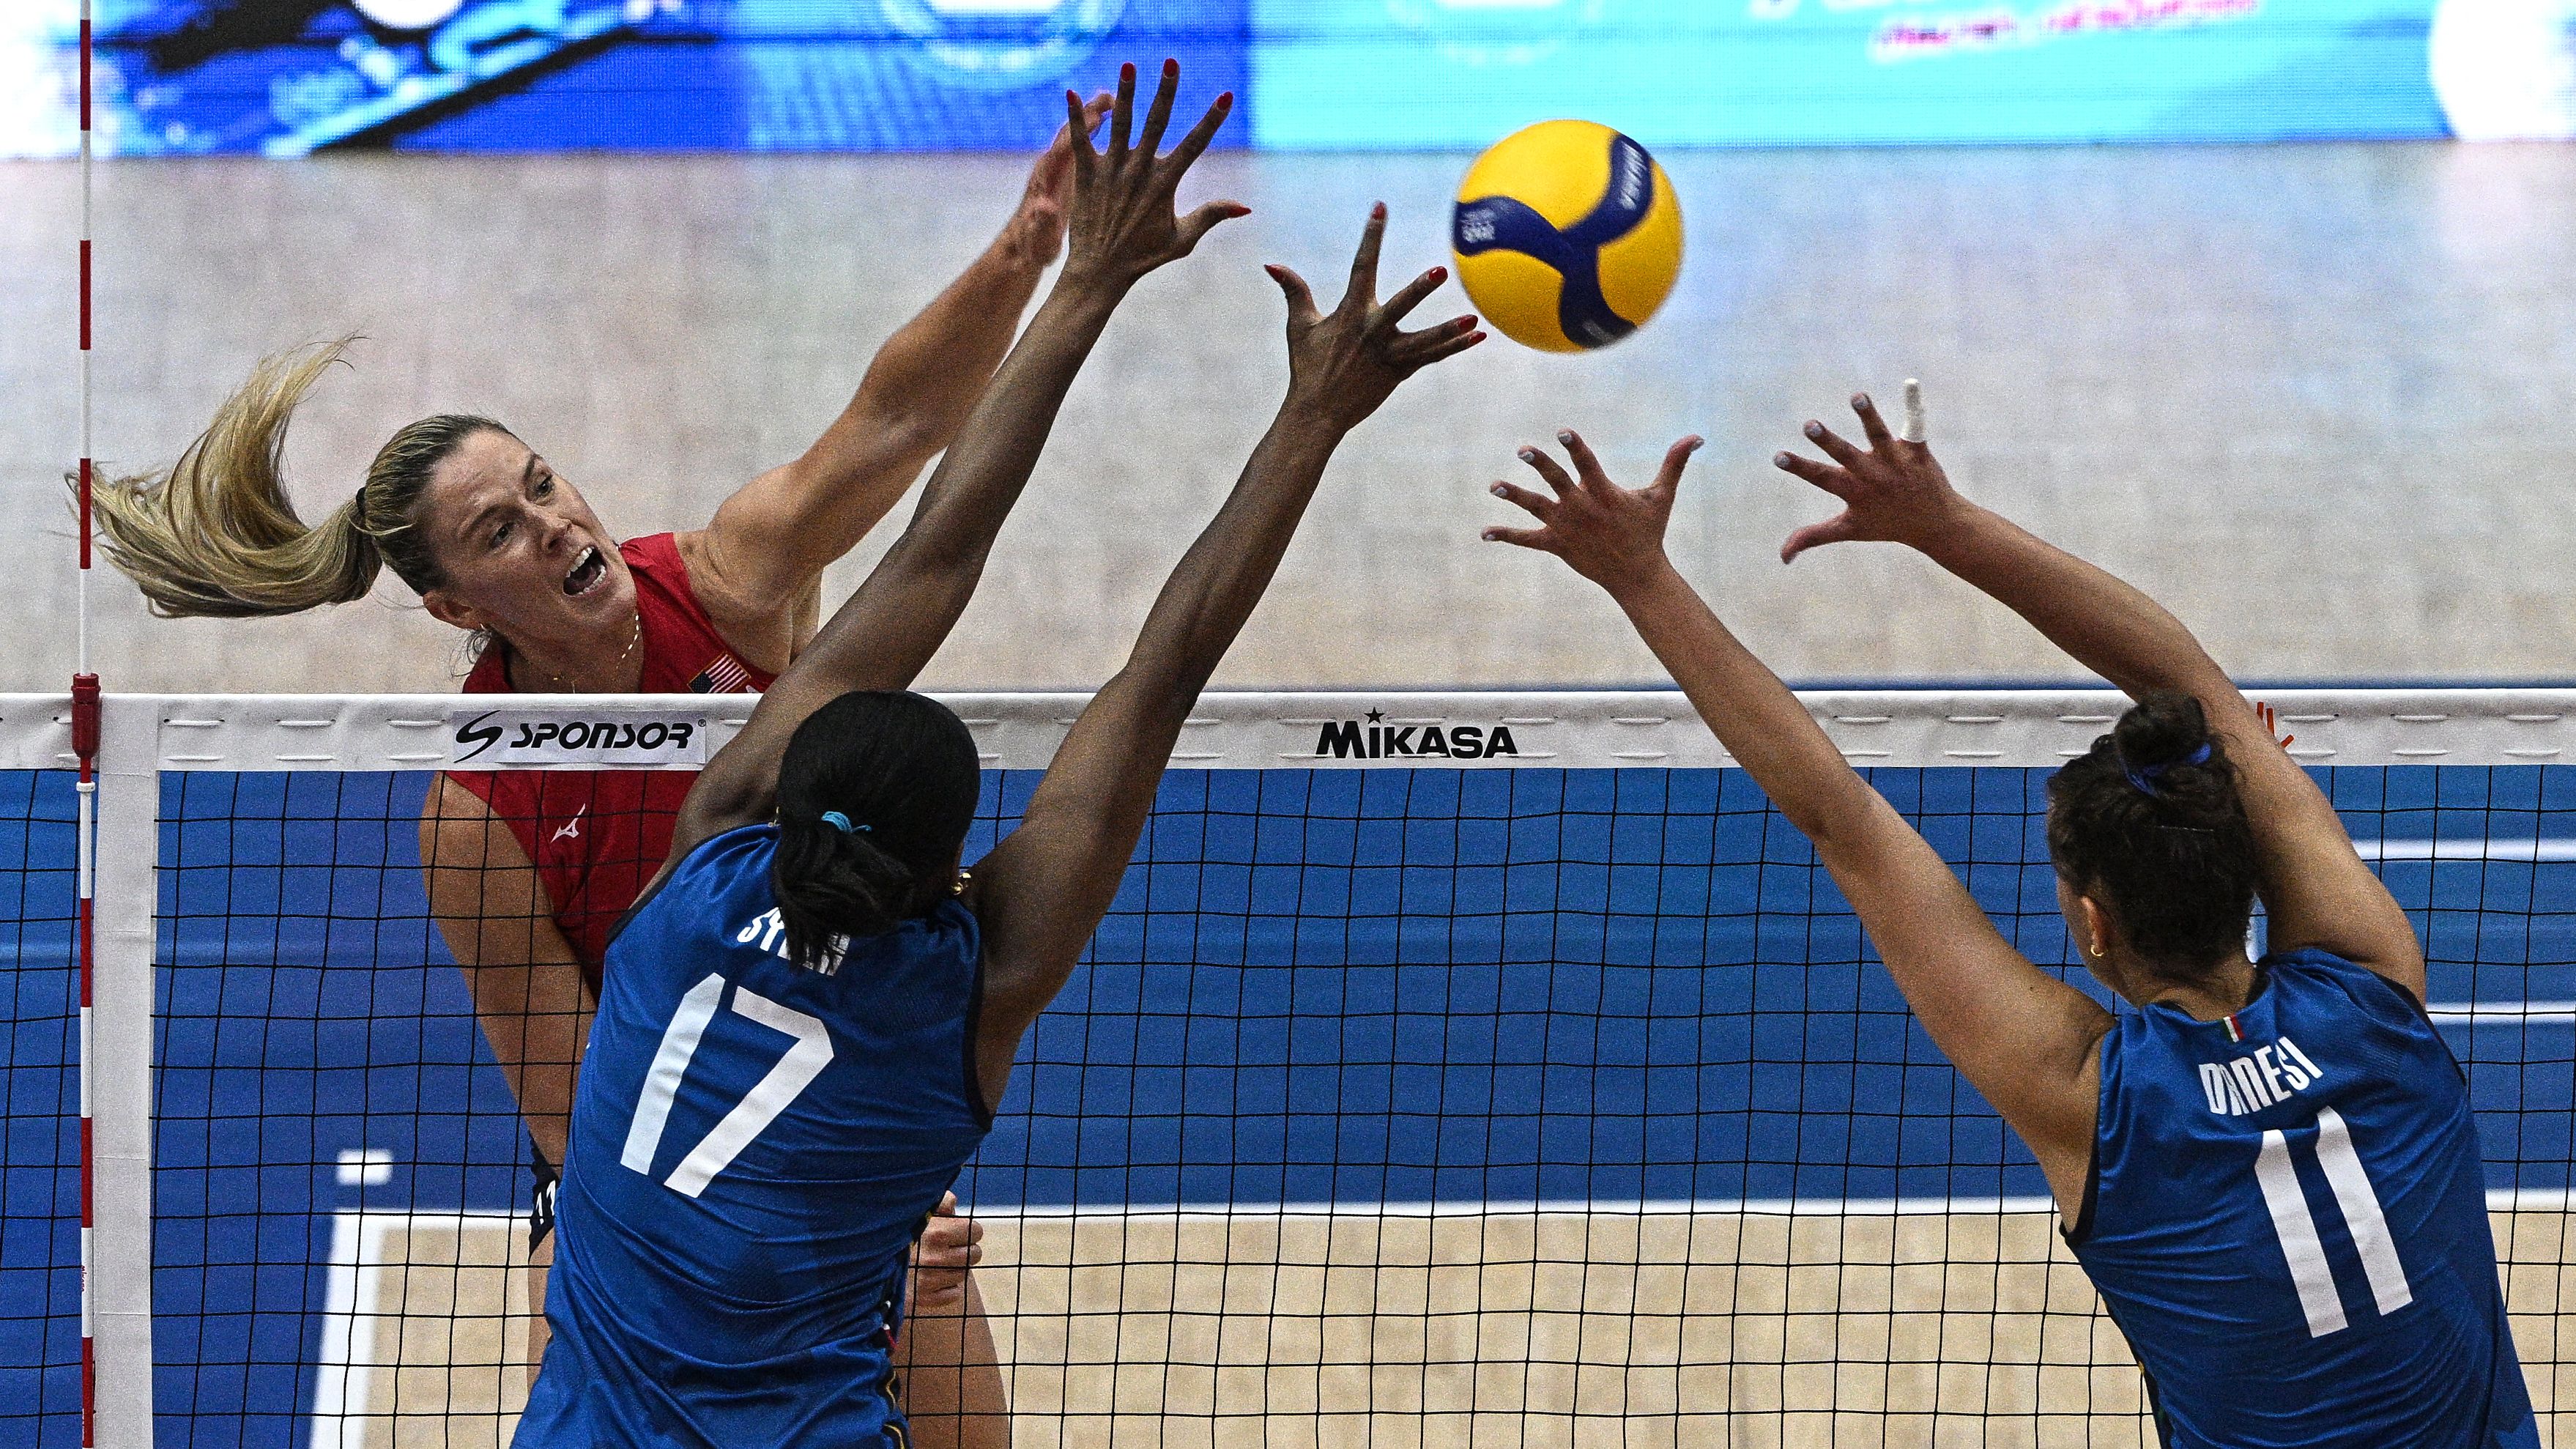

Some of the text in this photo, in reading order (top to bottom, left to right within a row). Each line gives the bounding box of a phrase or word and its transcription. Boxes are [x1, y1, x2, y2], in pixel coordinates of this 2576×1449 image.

[510, 722, 694, 750] SPONSOR
[1315, 707, 1519, 759] MIKASA
[620, 972, 835, 1198] 17
[2198, 1036, 2323, 1116] DANESI
[2254, 1105, 2413, 1338] 11
